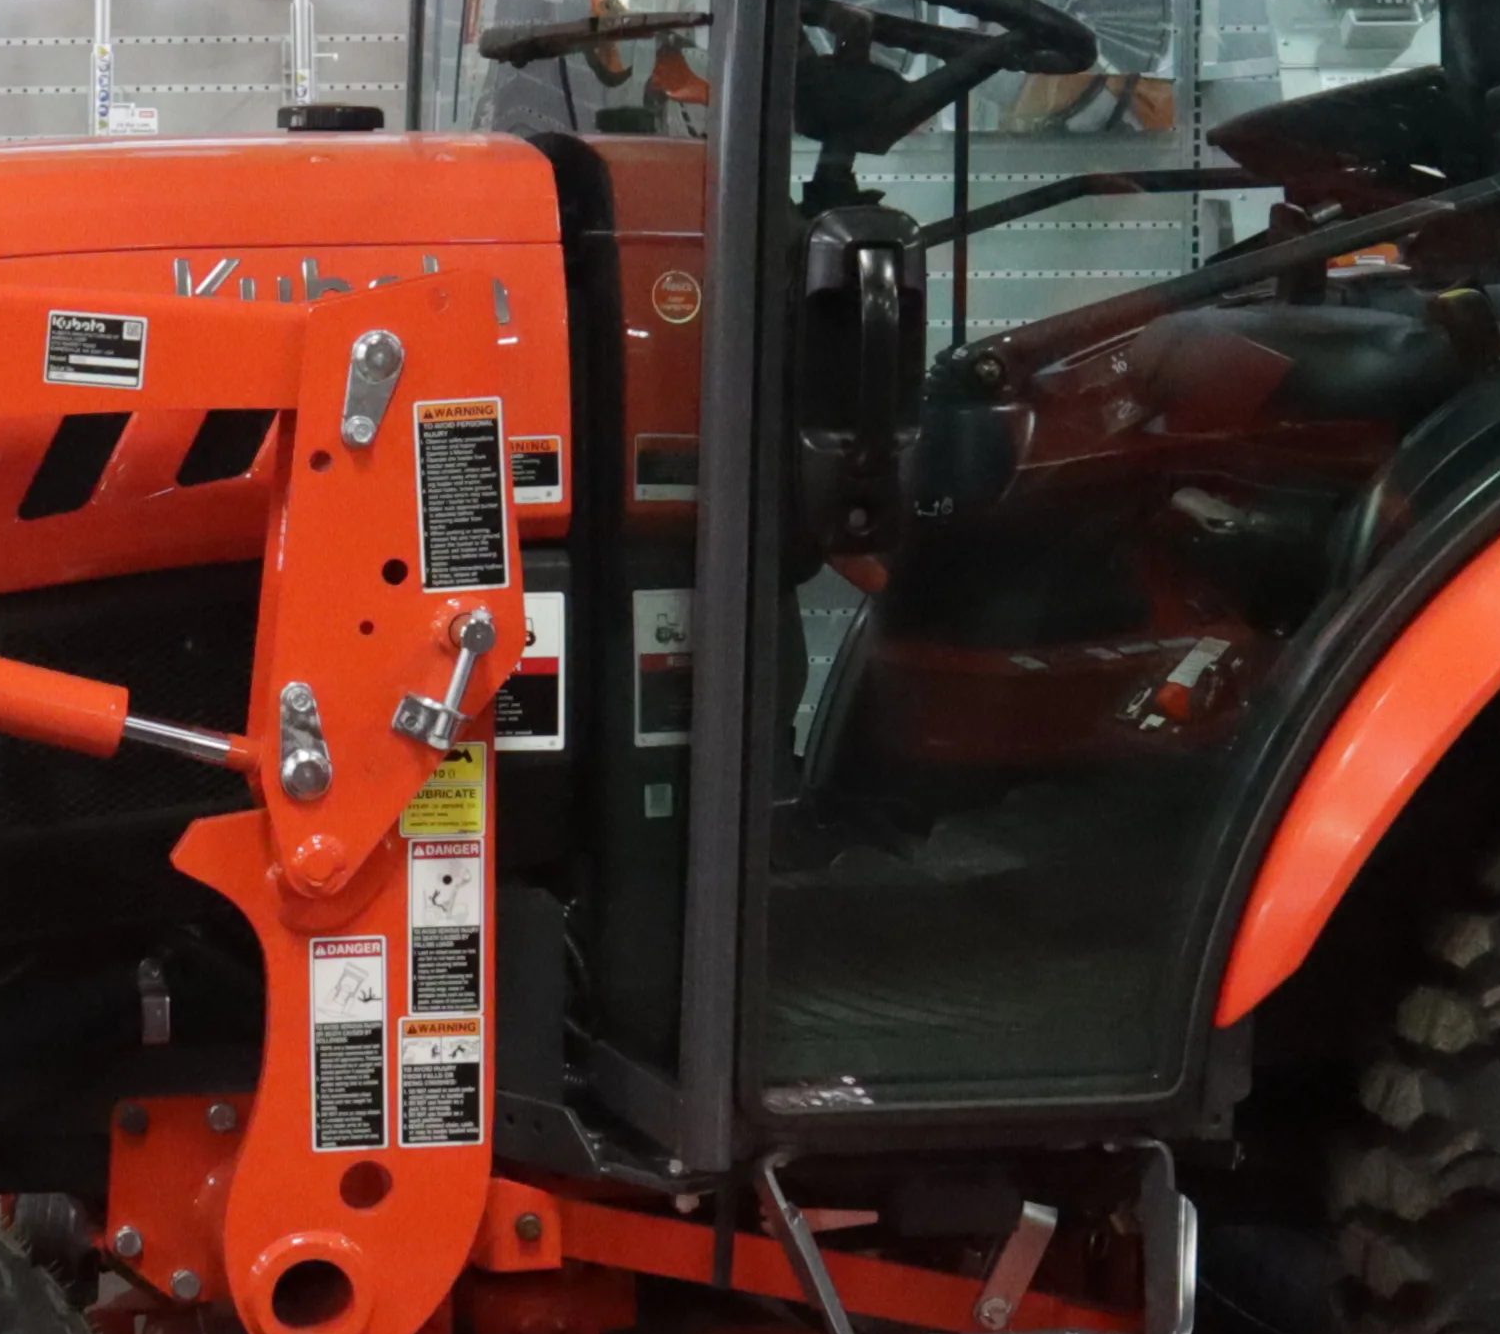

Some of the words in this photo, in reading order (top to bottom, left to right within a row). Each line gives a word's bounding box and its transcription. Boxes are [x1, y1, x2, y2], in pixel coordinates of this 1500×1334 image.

[52, 316, 106, 333] Kubota
[434, 405, 494, 418] WARNING
[426, 844, 480, 856] DANGER
[327, 943, 381, 955] DANGER
[419, 1022, 476, 1033] WARNING
